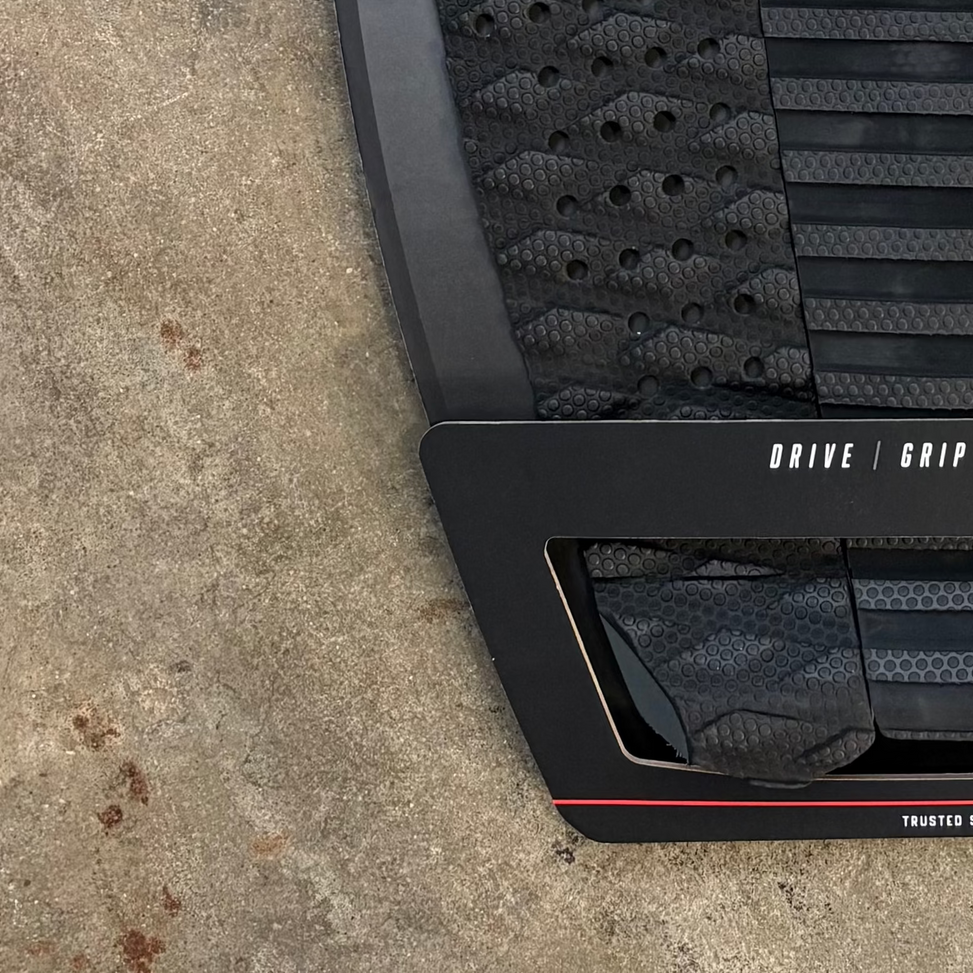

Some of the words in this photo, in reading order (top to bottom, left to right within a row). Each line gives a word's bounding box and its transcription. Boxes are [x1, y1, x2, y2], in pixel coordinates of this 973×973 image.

[769, 442, 854, 470] DRIVE
[900, 442, 967, 468] GRIP
[902, 815, 963, 827] TRUSTED
